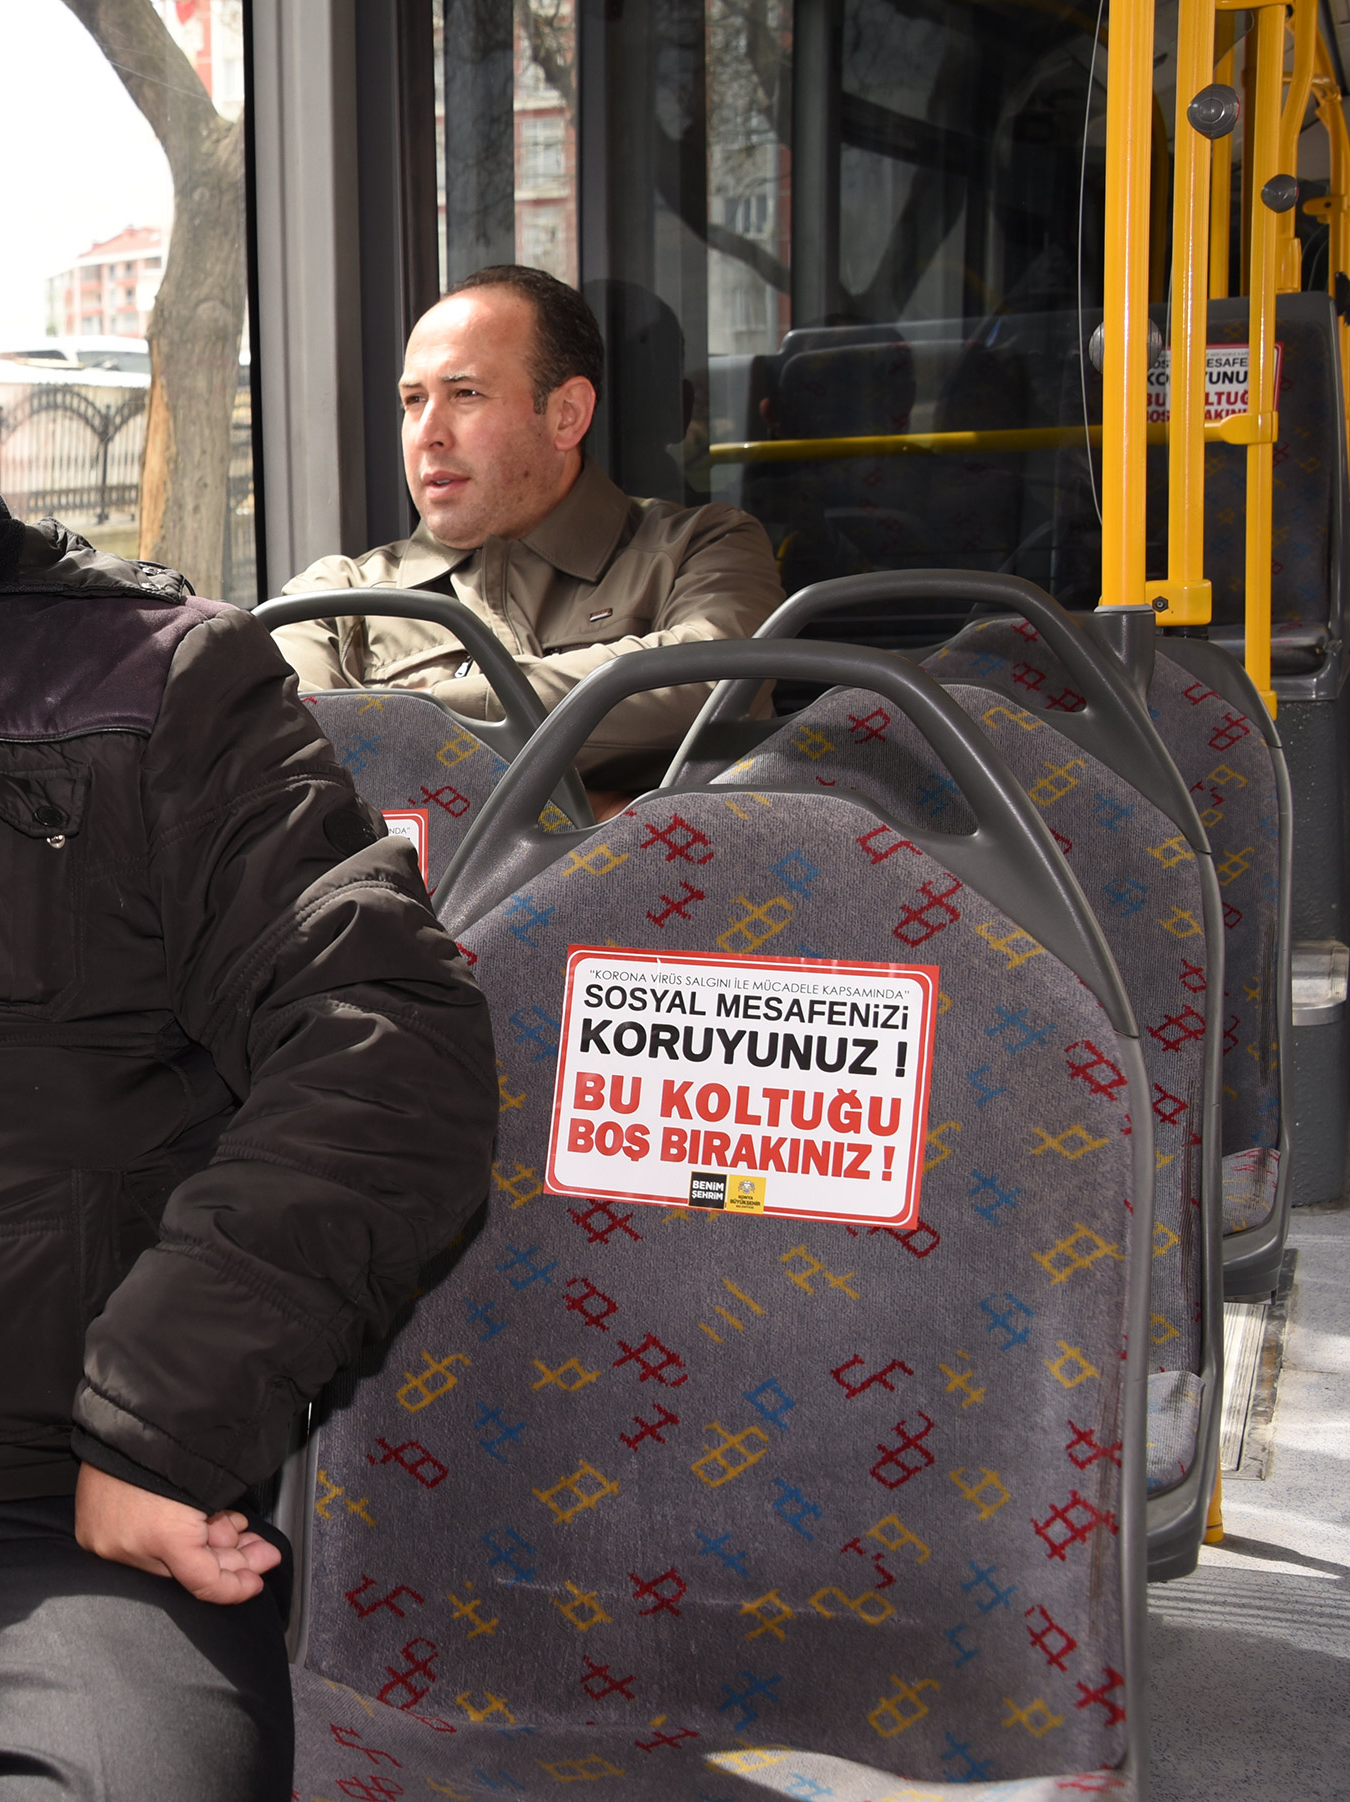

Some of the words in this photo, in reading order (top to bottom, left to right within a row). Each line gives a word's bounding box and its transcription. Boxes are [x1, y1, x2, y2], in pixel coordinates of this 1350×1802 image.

[584, 984, 706, 1016] SOSYAL
[685, 976, 731, 988] SALGINI
[752, 980, 819, 995] MÜCADELE
[579, 1018, 878, 1076] KORUYUNUZ
[573, 1071, 642, 1115] BU
[660, 1079, 902, 1137] KOLTUĞU
[567, 1117, 651, 1162] BOŞ
[660, 1127, 872, 1180] BIRAKINIZ
